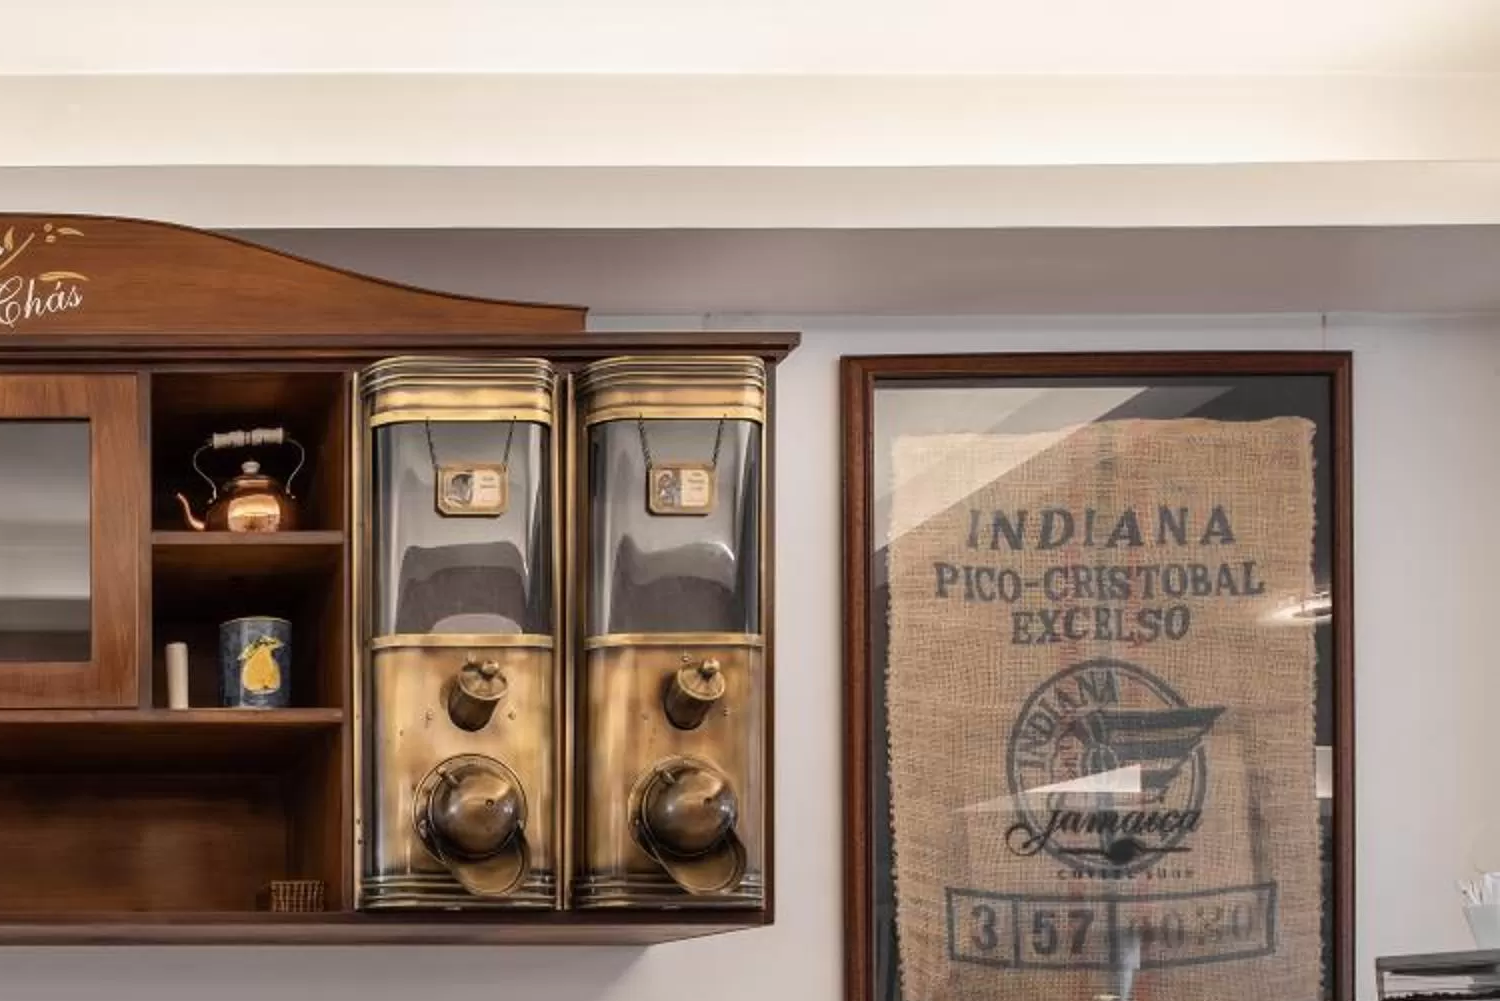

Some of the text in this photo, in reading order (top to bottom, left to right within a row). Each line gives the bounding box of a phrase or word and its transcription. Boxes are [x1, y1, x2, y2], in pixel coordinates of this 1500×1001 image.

[966, 504, 1236, 551] INDIANA
[933, 561, 1266, 603] PICO-CRISTOBAL
[1011, 604, 1192, 645] EXCELSO
[971, 903, 999, 950] 3
[1032, 908, 1095, 955] 57
